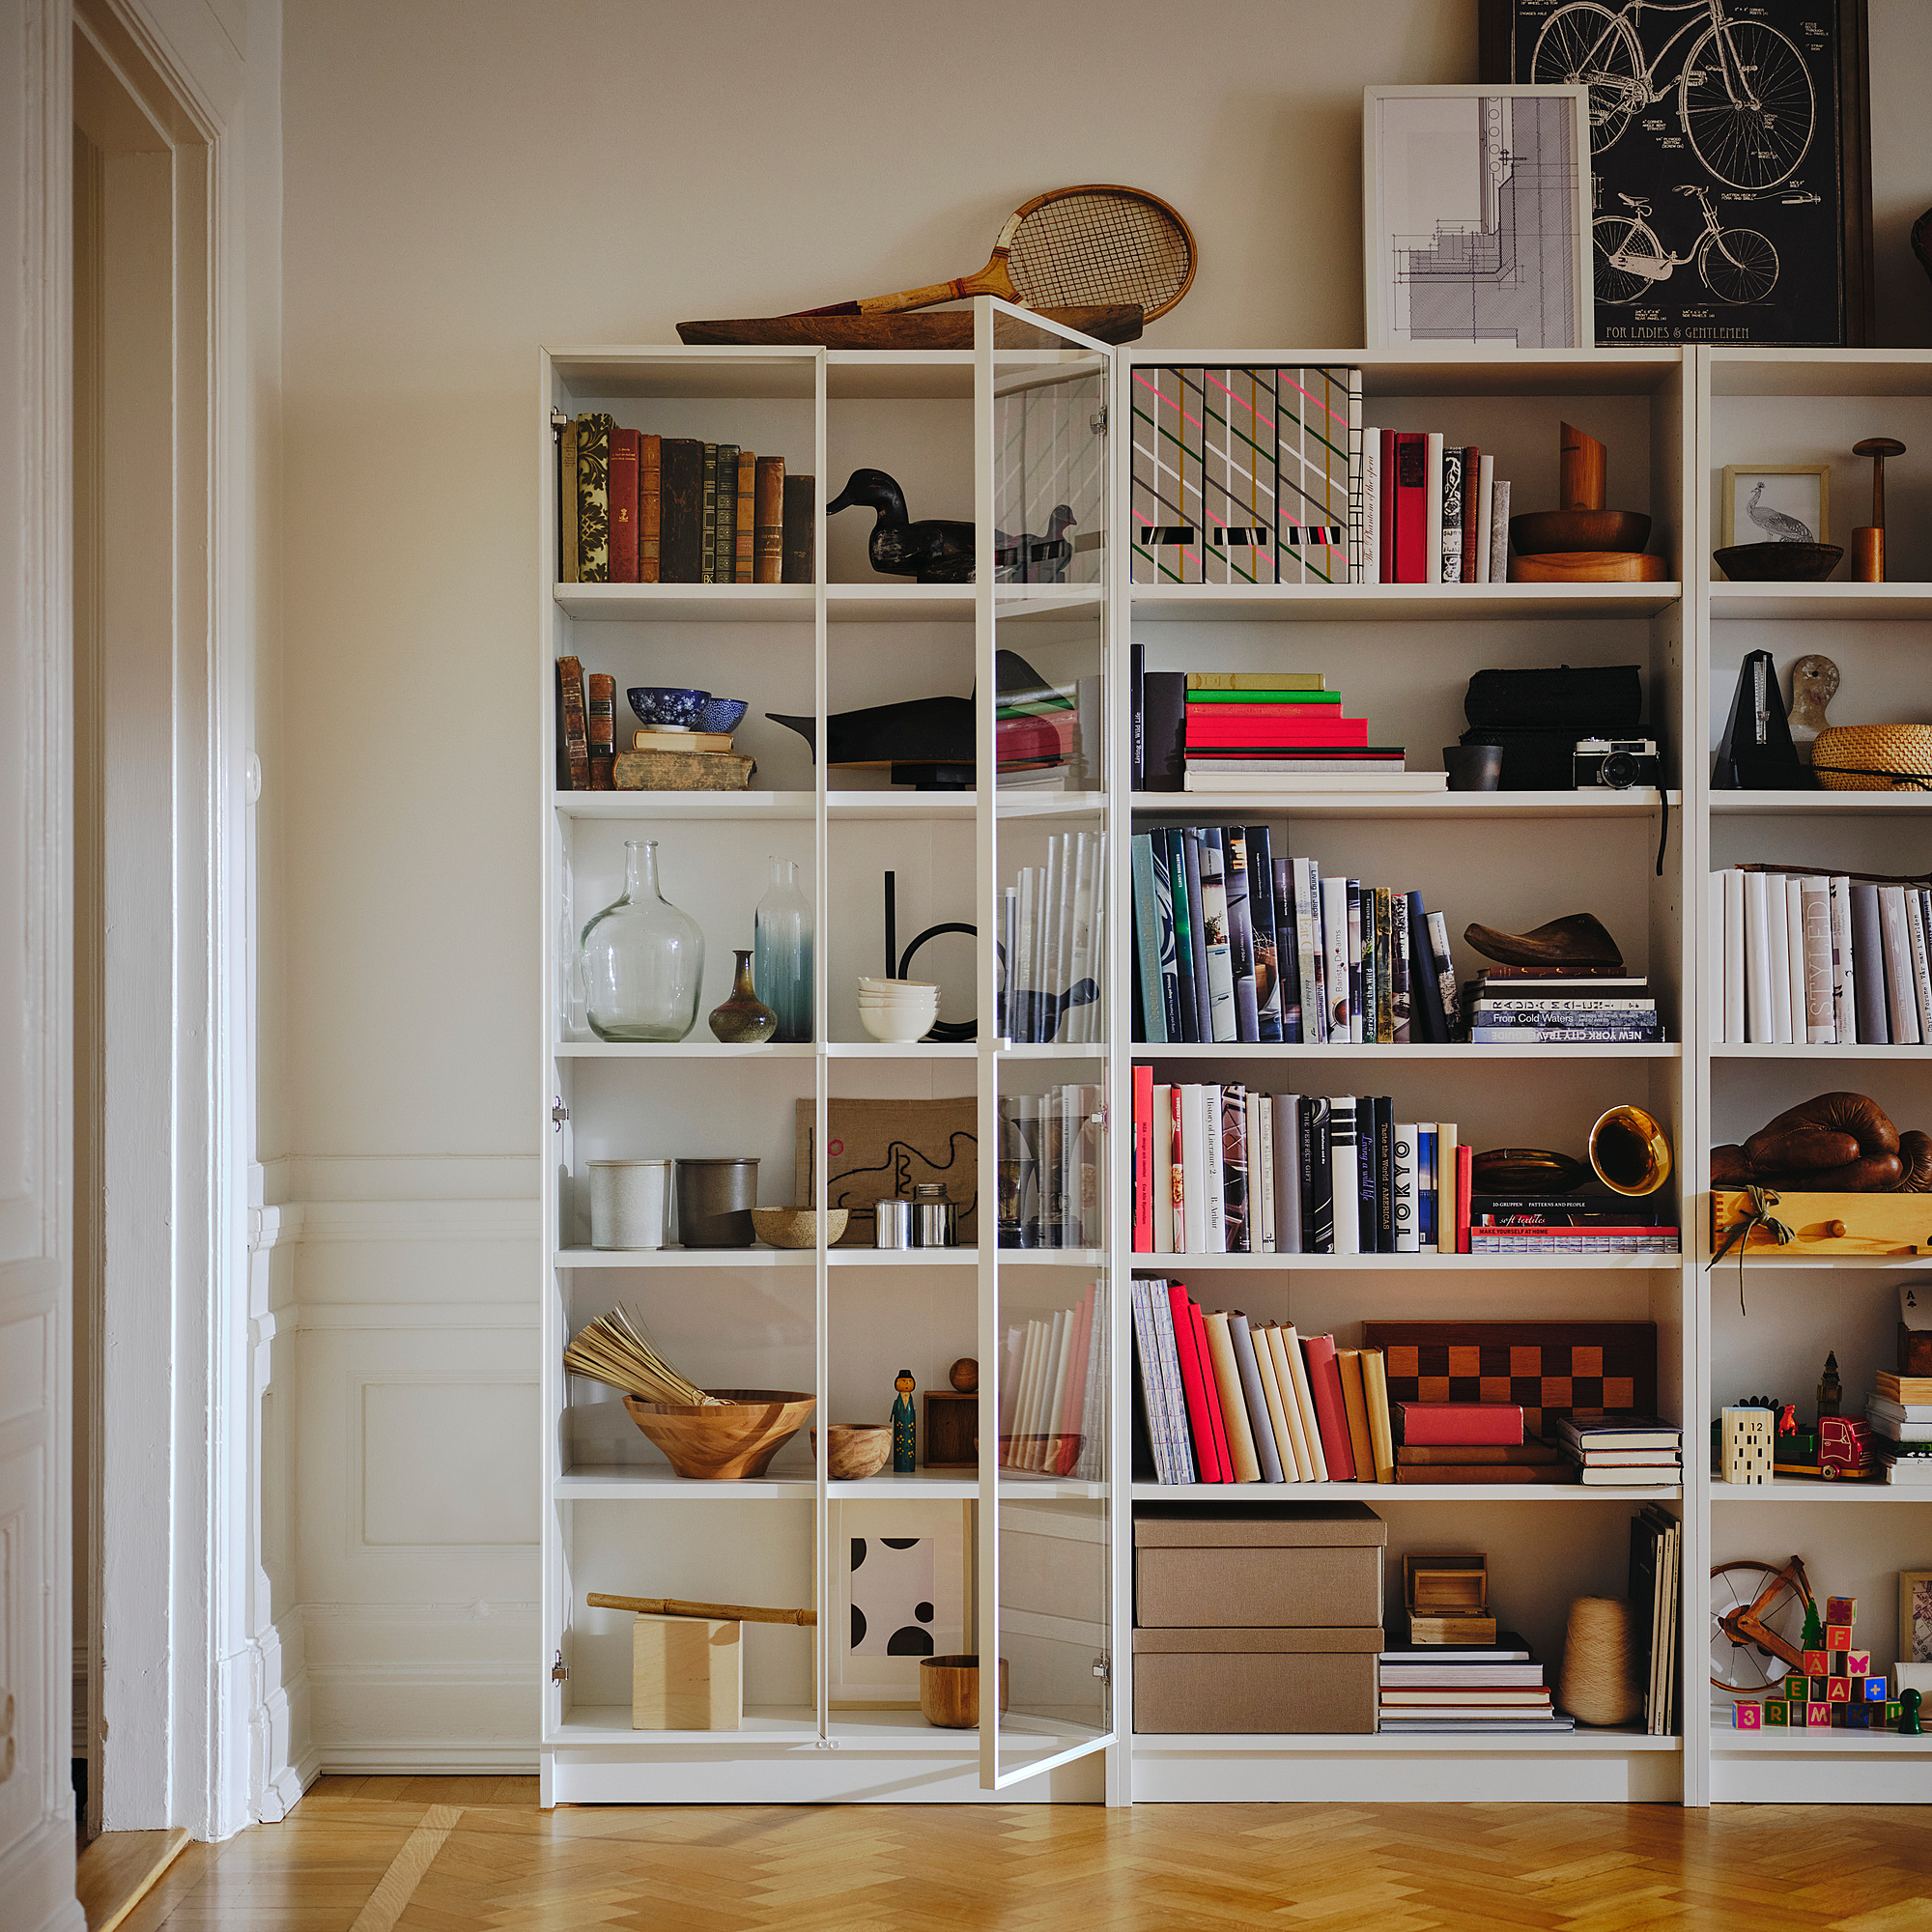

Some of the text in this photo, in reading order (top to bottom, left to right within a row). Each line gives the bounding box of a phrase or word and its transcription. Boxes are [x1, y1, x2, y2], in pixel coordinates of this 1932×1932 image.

[1605, 327, 1749, 339] FOR LADIES & GENTLEMEN
[1364, 455, 1378, 568] The Phantom of the opera
[1310, 869, 1319, 891] Living
[1312, 899, 1321, 921] Japan
[1299, 918, 1313, 938] Eat
[1145, 941, 1155, 952] in
[1806, 901, 1833, 1016] STYLED
[1146, 952, 1160, 1023] Neoclassicism
[1335, 964, 1344, 993] Barista
[1493, 1013, 1516, 1023] From
[1518, 1013, 1539, 1023] Cold
[1542, 1013, 1574, 1023] Waters
[1491, 1031, 1642, 1040] NEW YORK CITY TRAVEL GUIDE
[1206, 1097, 1214, 1123] History
[1208, 1123, 1215, 1132] of
[1380, 1122, 1389, 1144] Taste
[1358, 1132, 1374, 1161] Living
[1362, 1170, 1375, 1188] wild
[1394, 1141, 1411, 1237] TOKYO
[1359, 1189, 1375, 1202] life
[1382, 1187, 1391, 1230] AMERICAS
[1906, 1290, 1916, 1300] A
[1751, 1422, 1763, 1432] 12
[1834, 1631, 1845, 1646] F
[1809, 1653, 1824, 1674] Ä
[1791, 1681, 1802, 1697] E
[1832, 1682, 1845, 1698] A
[1743, 1709, 1756, 1726] 3
[1771, 1705, 1782, 1722] R
[1810, 1706, 1829, 1723] M
[1852, 1708, 1865, 1723] K
